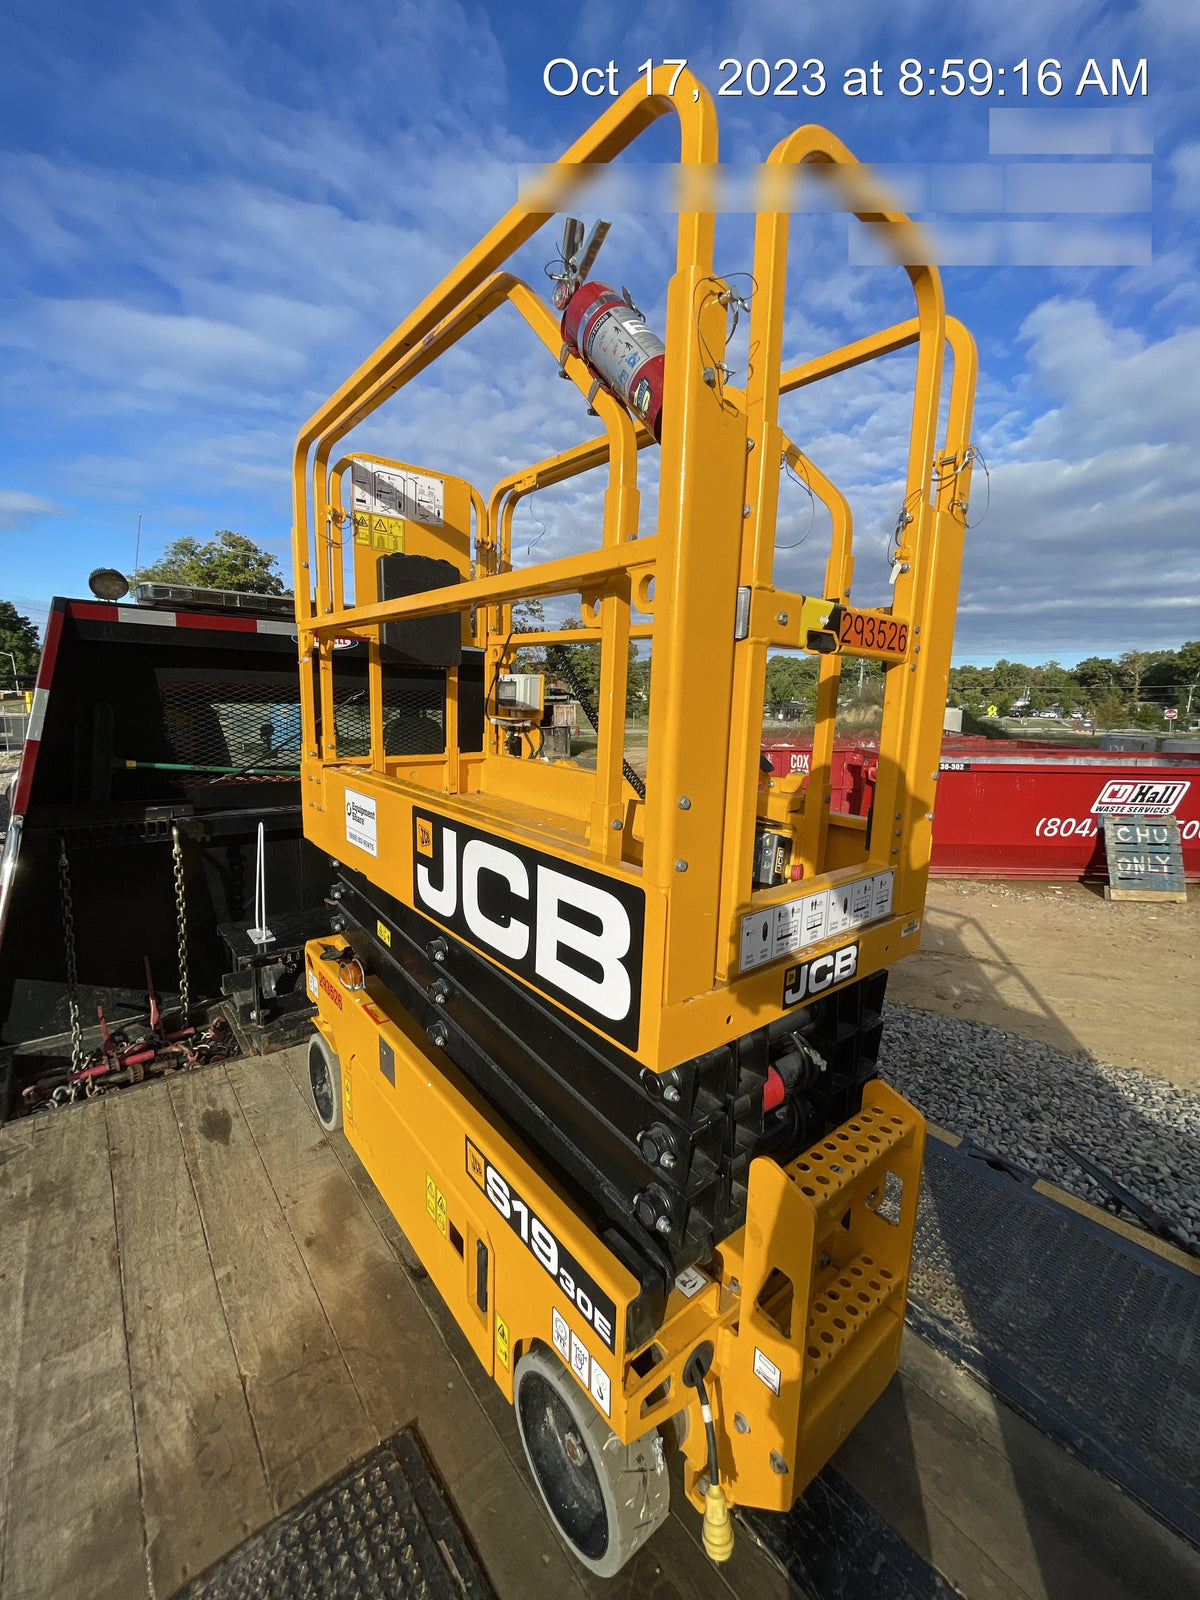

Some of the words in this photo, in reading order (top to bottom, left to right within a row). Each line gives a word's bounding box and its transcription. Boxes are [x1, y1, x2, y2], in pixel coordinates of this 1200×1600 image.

[840, 611, 908, 653] 293526
[790, 754, 809, 769] COX
[939, 763, 965, 771] 30-302
[1130, 785, 1178, 804] Hall
[351, 802, 375, 820] Equipment
[352, 812, 365, 825] Share
[1127, 806, 1171, 814] SERVICES
[1117, 826, 1168, 843] CHU
[1117, 856, 1170, 880] ONLY
[416, 826, 631, 1021] JCB
[785, 945, 857, 1004] JCB
[486, 1165, 559, 1277] S19
[559, 1266, 612, 1345] 30E
